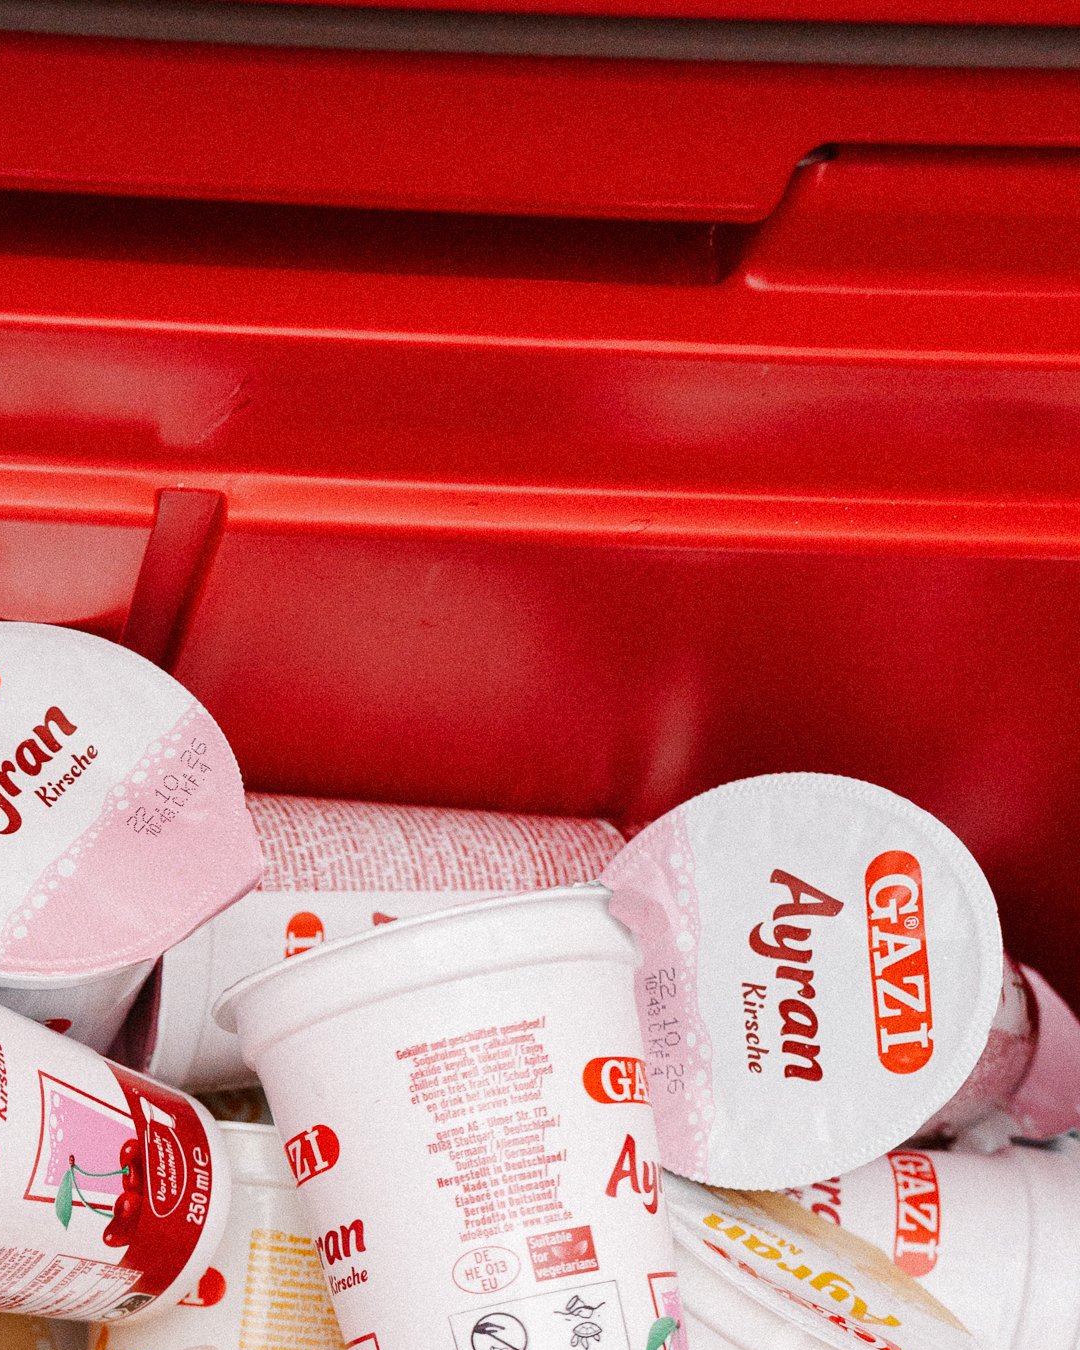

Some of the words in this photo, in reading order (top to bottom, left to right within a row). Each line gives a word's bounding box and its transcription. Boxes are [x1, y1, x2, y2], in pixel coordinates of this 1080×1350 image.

[33, 744, 99, 808] Kirsche
[126, 737, 208, 834] 22.10.26
[749, 868, 845, 1082] Ayran
[866, 874, 928, 1053] GAZI
[658, 968, 686, 1096] 22.10.26
[741, 982, 770, 1074] Kirsche
[601, 1059, 650, 1102] GA
[153, 1130, 166, 1178] Verzehr
[163, 1138, 176, 1195] schütteln!
[287, 1128, 329, 1184] ZI
[158, 1178, 167, 1202] Vor
[186, 1190, 207, 1226] 250
[313, 1219, 367, 1269] ran
[473, 1250, 490, 1264] DE
[528, 1231, 573, 1248] Suitable
[531, 1251, 549, 1263] for
[328, 1265, 369, 1296] Kirsche
[465, 1266, 484, 1280] HE
[485, 1262, 507, 1276] 013
[481, 1277, 498, 1291] EU
[536, 1257, 597, 1279] vegetarians
[703, 1212, 901, 1328] Ayran
